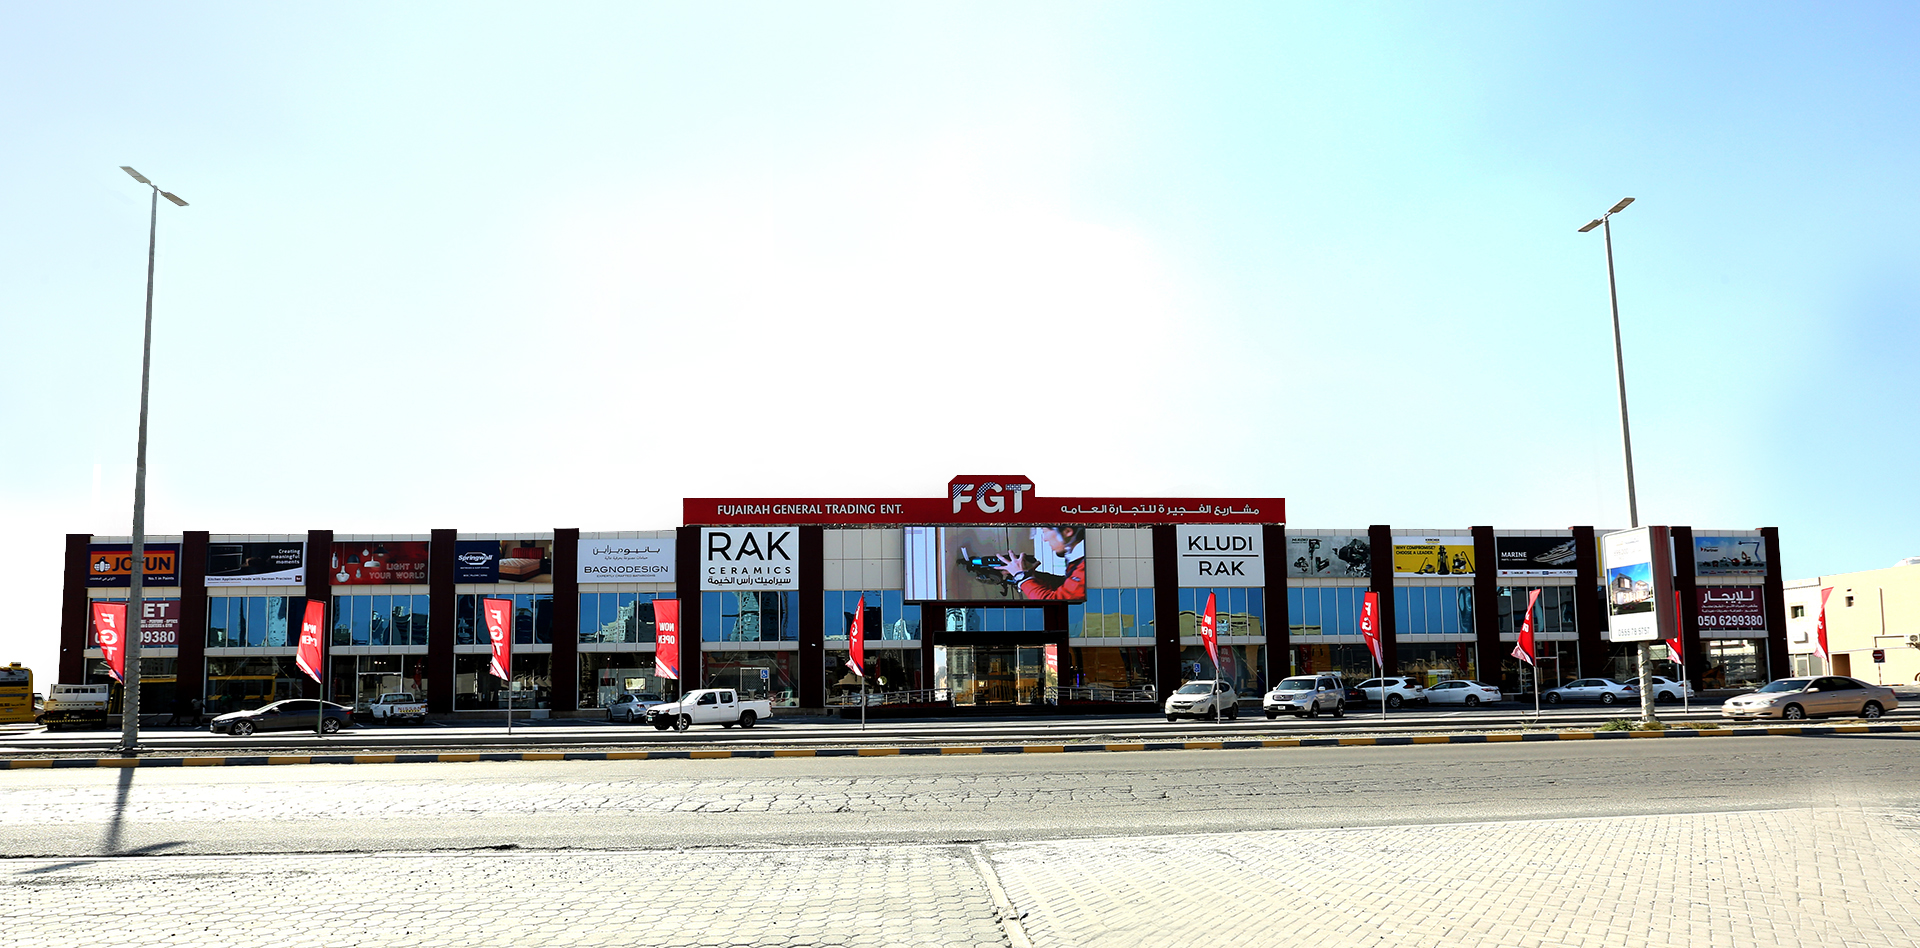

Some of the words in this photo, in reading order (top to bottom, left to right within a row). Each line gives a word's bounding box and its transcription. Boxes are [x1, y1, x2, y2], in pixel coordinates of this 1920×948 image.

[953, 482, 1032, 514] FGT
[717, 504, 770, 516] FUJAIRAH
[772, 504, 822, 514] GENERAL
[825, 503, 876, 514] TRADING
[880, 503, 904, 514] ENT.
[1109, 504, 1157, 516] للتجارة
[1214, 504, 1260, 516] مشاريع
[708, 531, 791, 561] RAK
[1188, 535, 1253, 551] KLUDI
[112, 556, 171, 571] JOUN
[386, 563, 410, 571] LIGHT
[414, 563, 426, 571] UP
[584, 565, 669, 574] BAGNODESIGN
[1199, 561, 1245, 576] RAK
[708, 566, 791, 575] CERAMICS
[707, 576, 735, 586] الخيمة
[736, 575, 753, 586] رأس
[754, 576, 791, 586] سيراميك
[1703, 590, 1755, 604] للإيجار
[143, 603, 169, 618] ET
[1698, 615, 1717, 626] 050
[1718, 615, 1763, 626] 6299380
